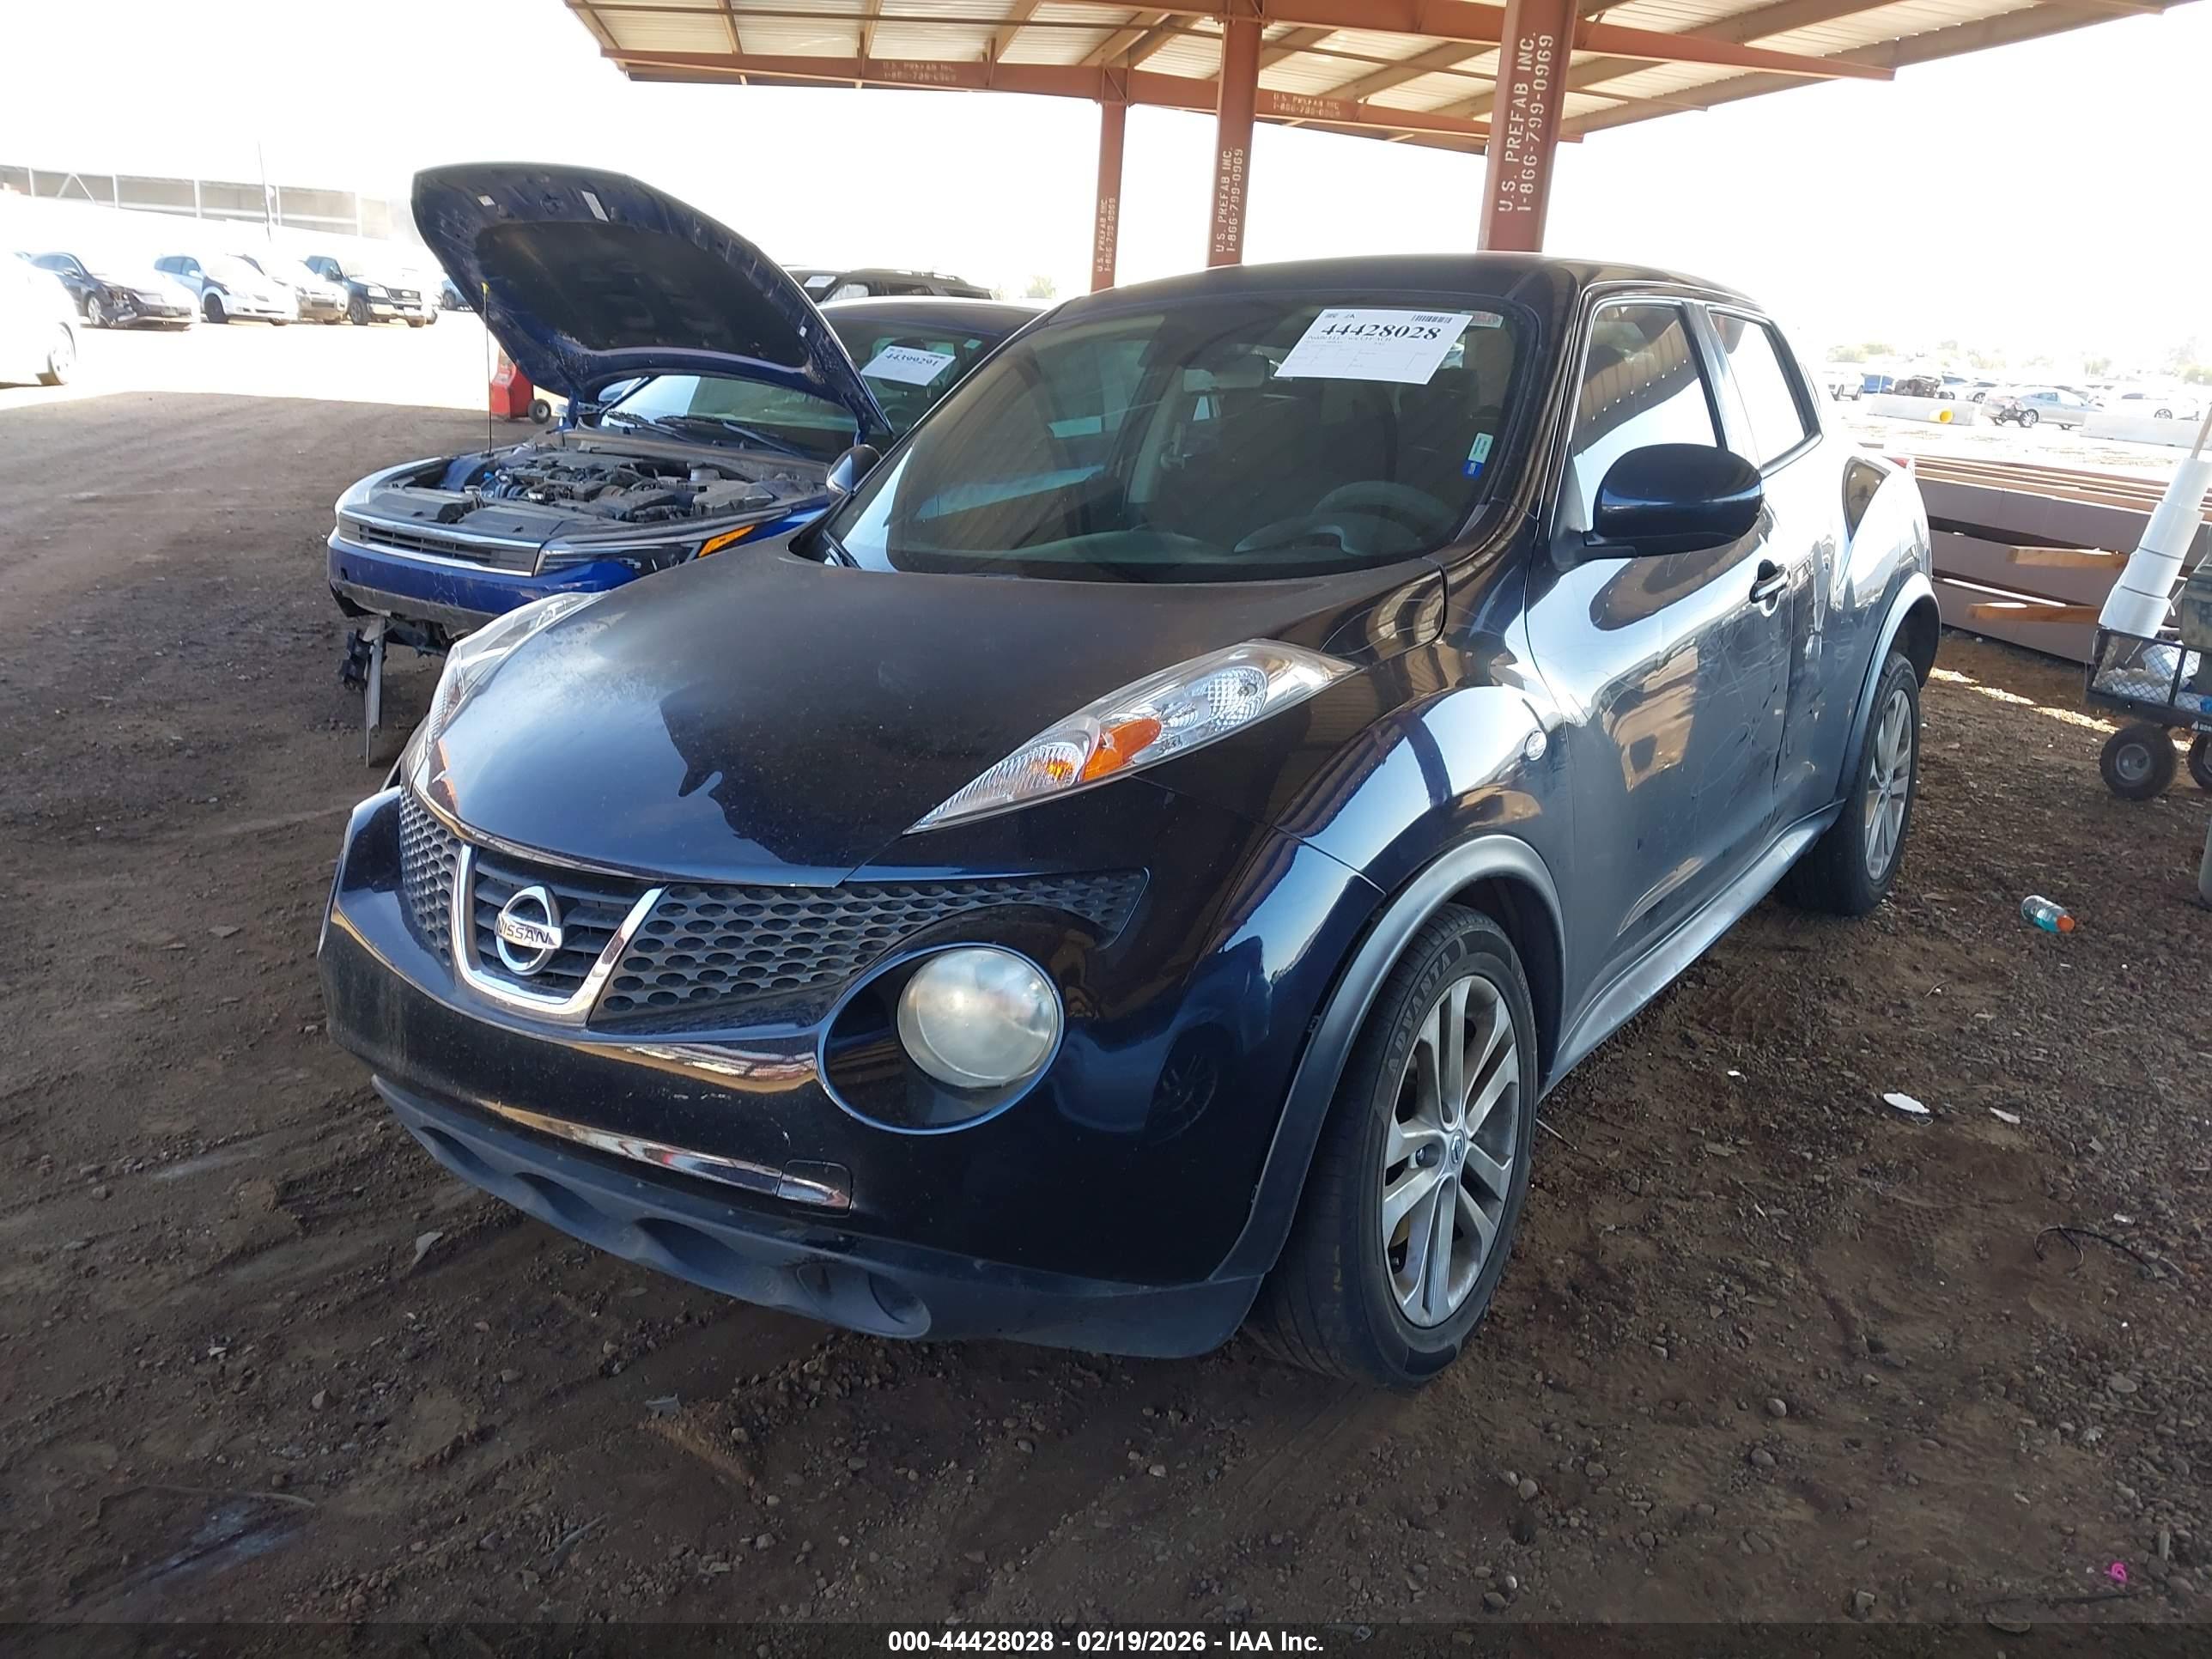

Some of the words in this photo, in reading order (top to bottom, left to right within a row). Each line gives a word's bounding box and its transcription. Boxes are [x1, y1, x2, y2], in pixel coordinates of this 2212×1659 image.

[1516, 32, 1536, 71] INC.
[1505, 83, 1528, 163] PREFAB
[1218, 176, 1231, 223] PREFAB
[1498, 174, 1517, 212] U.S.
[1321, 323, 1442, 340] 44428028
[497, 915, 550, 943] NISSAN
[1388, 952, 1451, 1074] ADVANTA
